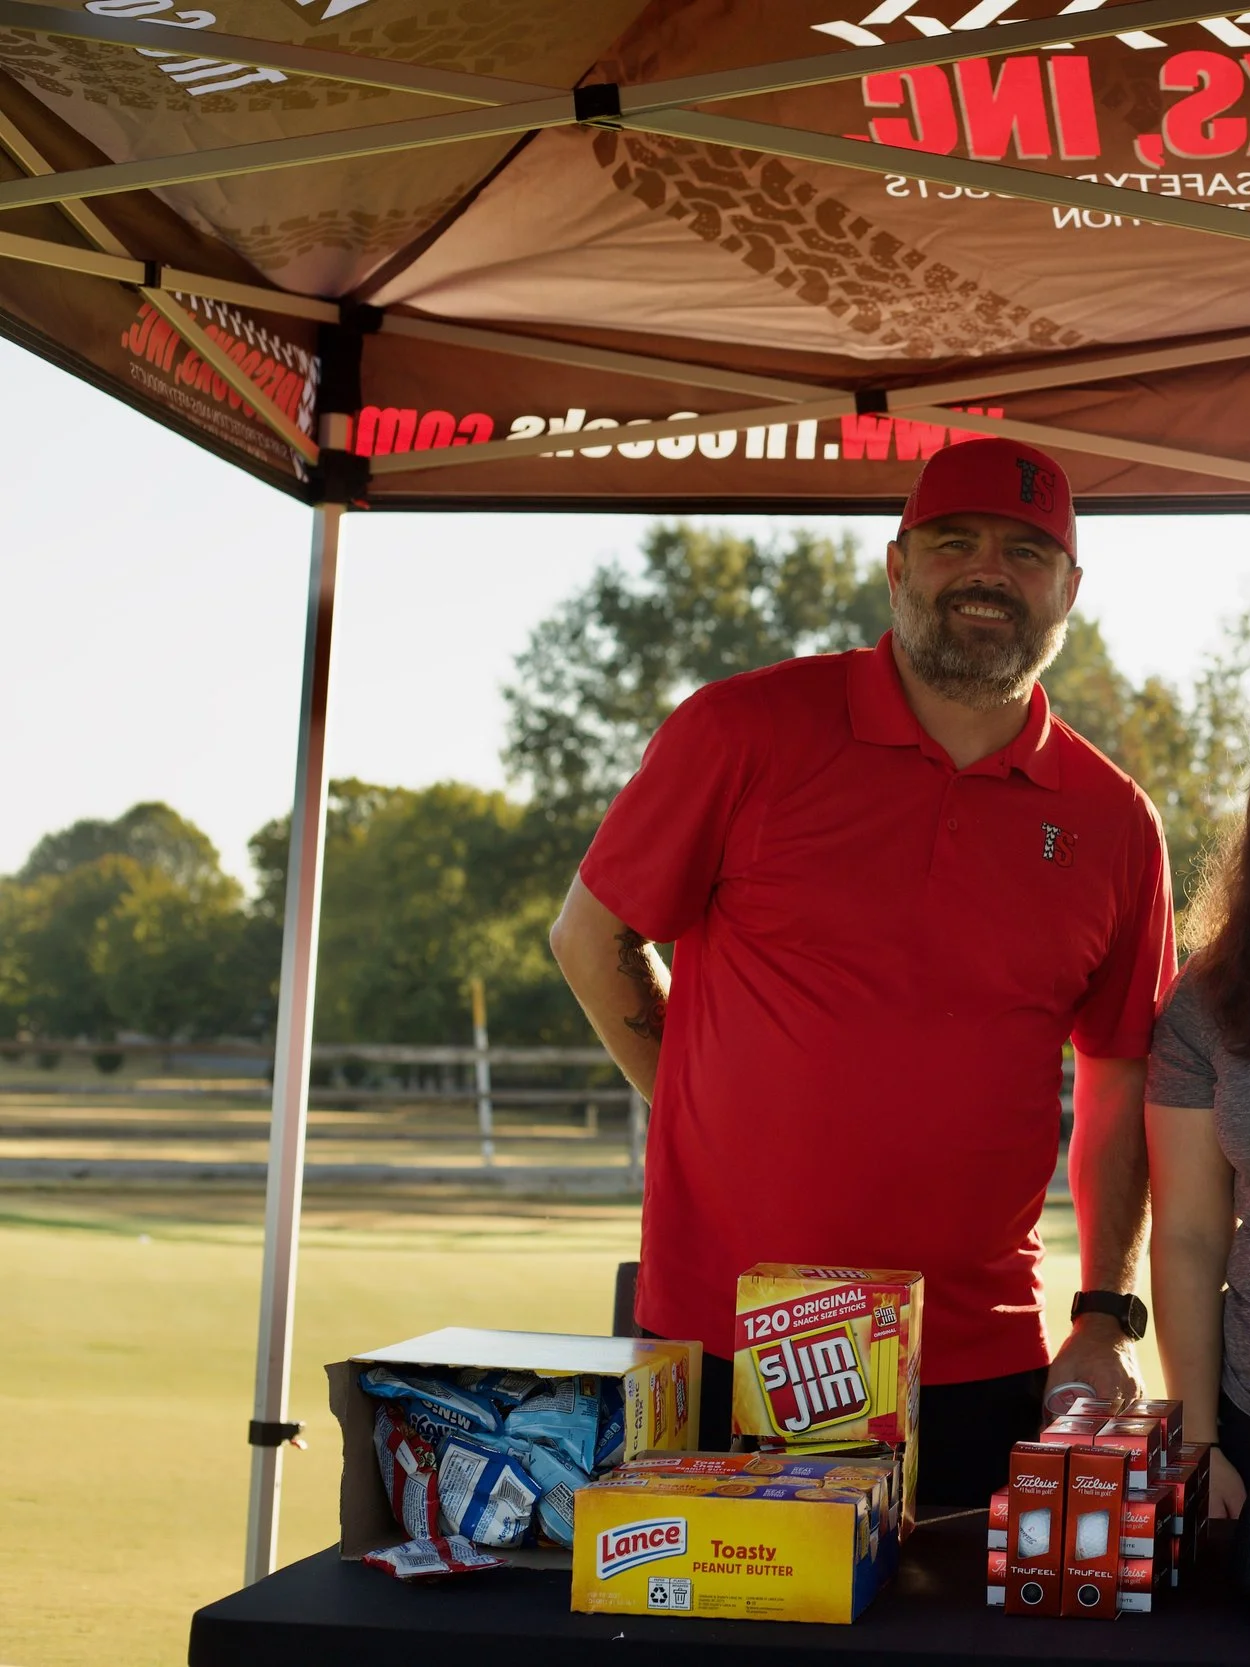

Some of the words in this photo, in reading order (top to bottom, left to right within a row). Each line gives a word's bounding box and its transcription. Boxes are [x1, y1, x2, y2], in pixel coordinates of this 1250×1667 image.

[1041, 822, 1076, 869] TS
[744, 1308, 791, 1340] 120
[792, 1288, 867, 1318] ORIGINAL
[793, 1314, 820, 1328] SNACK
[820, 1309, 838, 1320] SIZE
[838, 1302, 867, 1316] STICKS
[873, 1328, 898, 1338] ORIGINAL
[1013, 1474, 1060, 1489] Titleist
[1072, 1475, 1118, 1490] Titleist
[601, 1524, 681, 1564] Lance
[711, 1540, 776, 1562] Toasty
[692, 1562, 742, 1576] PEANUT
[746, 1564, 794, 1578] BUTTER
